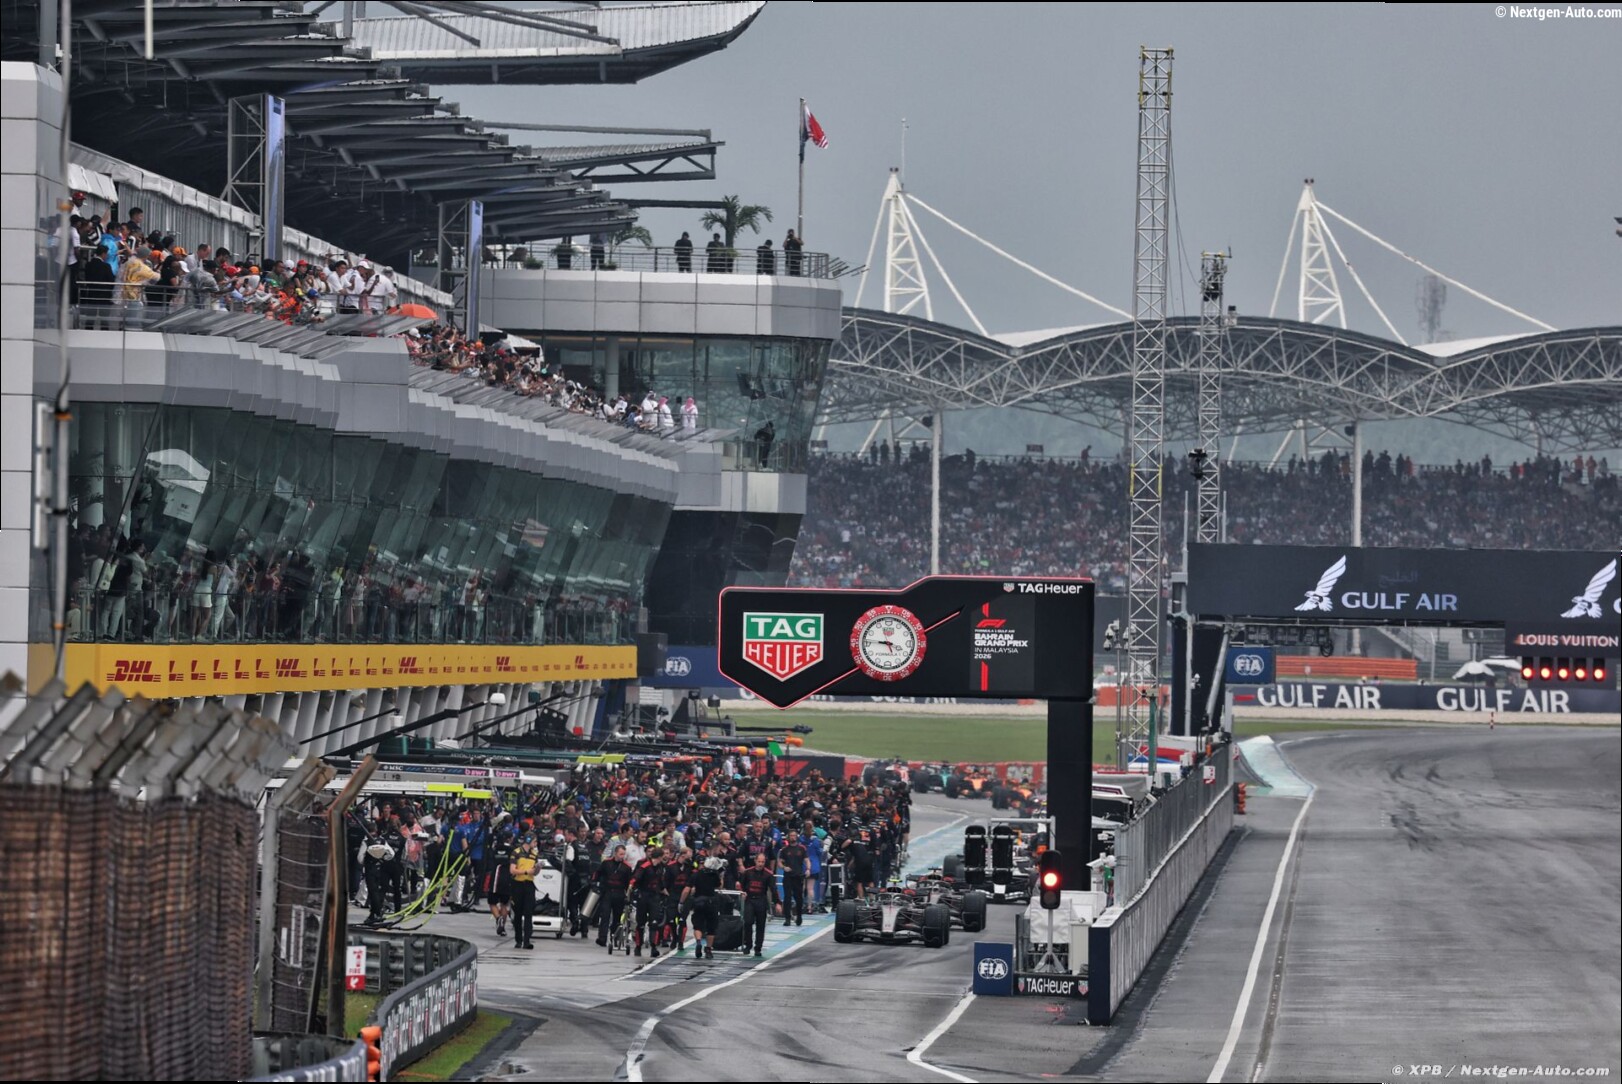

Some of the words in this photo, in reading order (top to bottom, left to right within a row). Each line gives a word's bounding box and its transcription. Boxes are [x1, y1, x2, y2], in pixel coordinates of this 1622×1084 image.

[1341, 592, 1410, 609] GULF
[1416, 593, 1457, 610] AIR
[751, 617, 816, 638] TAG
[1518, 634, 1559, 645] LOUIS
[1561, 635, 1619, 647] VUITTON
[666, 659, 690, 673] FIA
[748, 644, 818, 675] HEUER
[1235, 657, 1262, 673] FIA
[113, 660, 155, 682] DHL
[1257, 684, 1326, 707] GULF
[1335, 685, 1381, 709] AIR
[1436, 687, 1512, 712] GULF
[1521, 689, 1570, 713] AIR
[979, 961, 1006, 976] FIA
